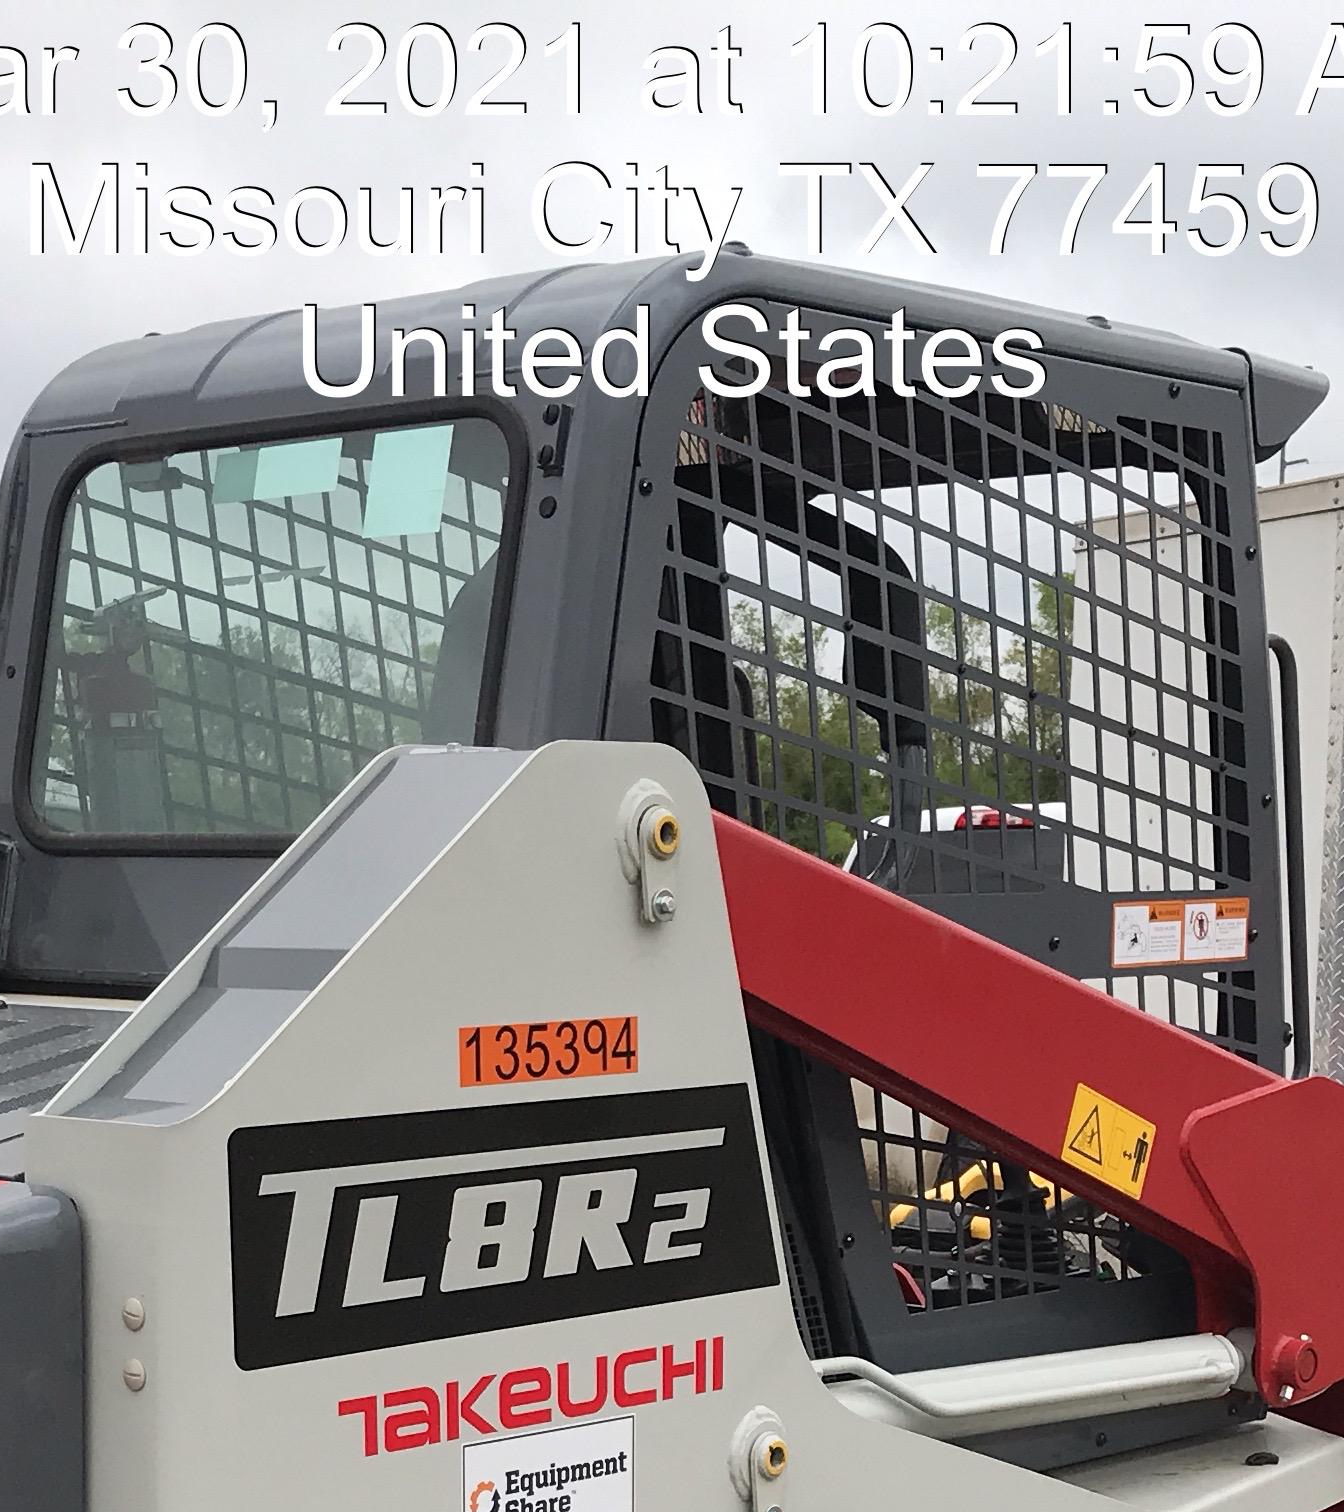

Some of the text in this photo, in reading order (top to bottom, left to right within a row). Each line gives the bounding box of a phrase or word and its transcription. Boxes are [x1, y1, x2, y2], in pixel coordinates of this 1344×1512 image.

[465, 1016, 637, 1082] 135394
[337, 1336, 725, 1458] TAKEUCHI
[505, 1451, 628, 1497] Equipment
